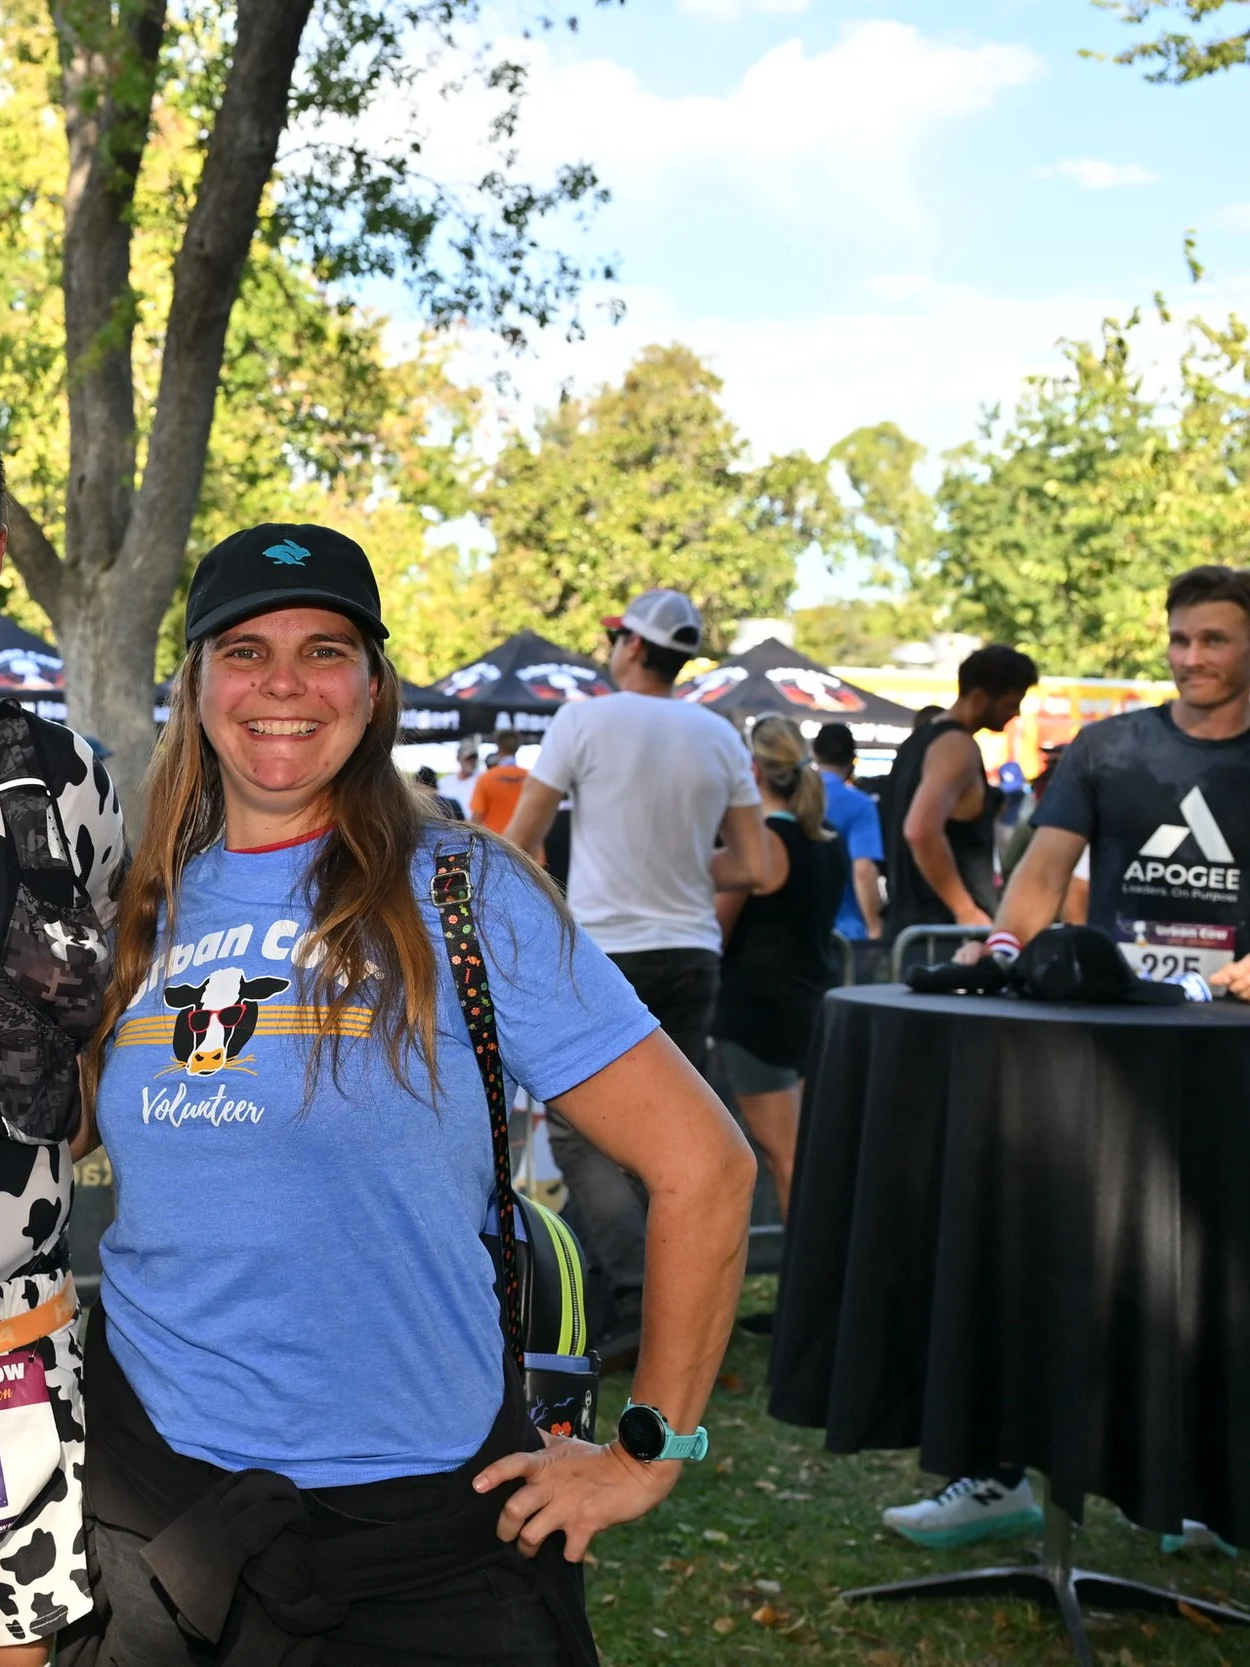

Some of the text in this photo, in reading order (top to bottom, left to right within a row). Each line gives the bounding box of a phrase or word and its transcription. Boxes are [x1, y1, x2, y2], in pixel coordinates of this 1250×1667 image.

[1123, 860, 1241, 890] APOGEE
[1142, 952, 1202, 981] 225
[141, 1082, 266, 1129] Volunteer
